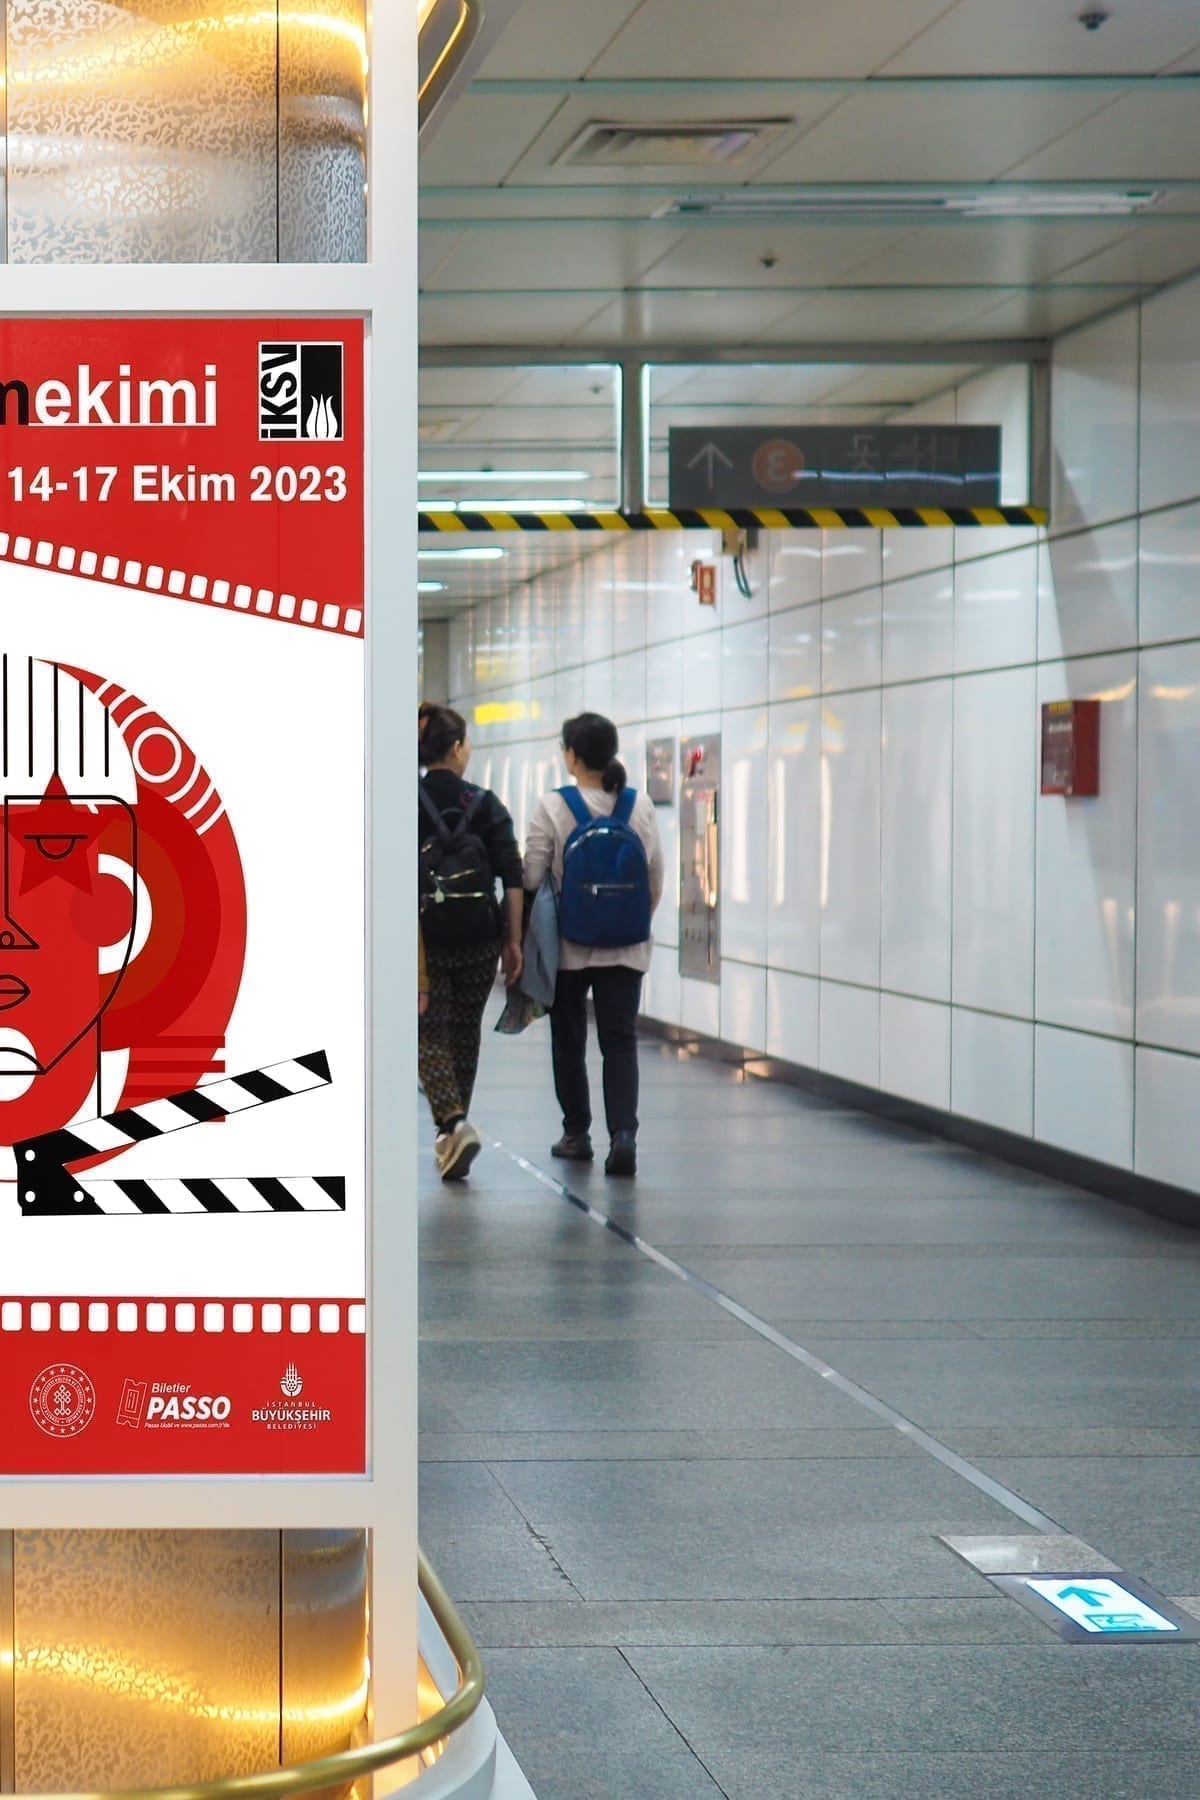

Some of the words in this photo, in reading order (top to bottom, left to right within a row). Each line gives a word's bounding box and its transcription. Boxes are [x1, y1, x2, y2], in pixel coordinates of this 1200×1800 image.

[7, 466, 118, 502] 14-17
[134, 465, 235, 502] Ekim
[249, 465, 348, 502] 2023
[151, 1382, 192, 1394] Biletler
[146, 1396, 232, 1421] PASSO
[252, 1407, 332, 1424] BÜYÜKŞEHİR
